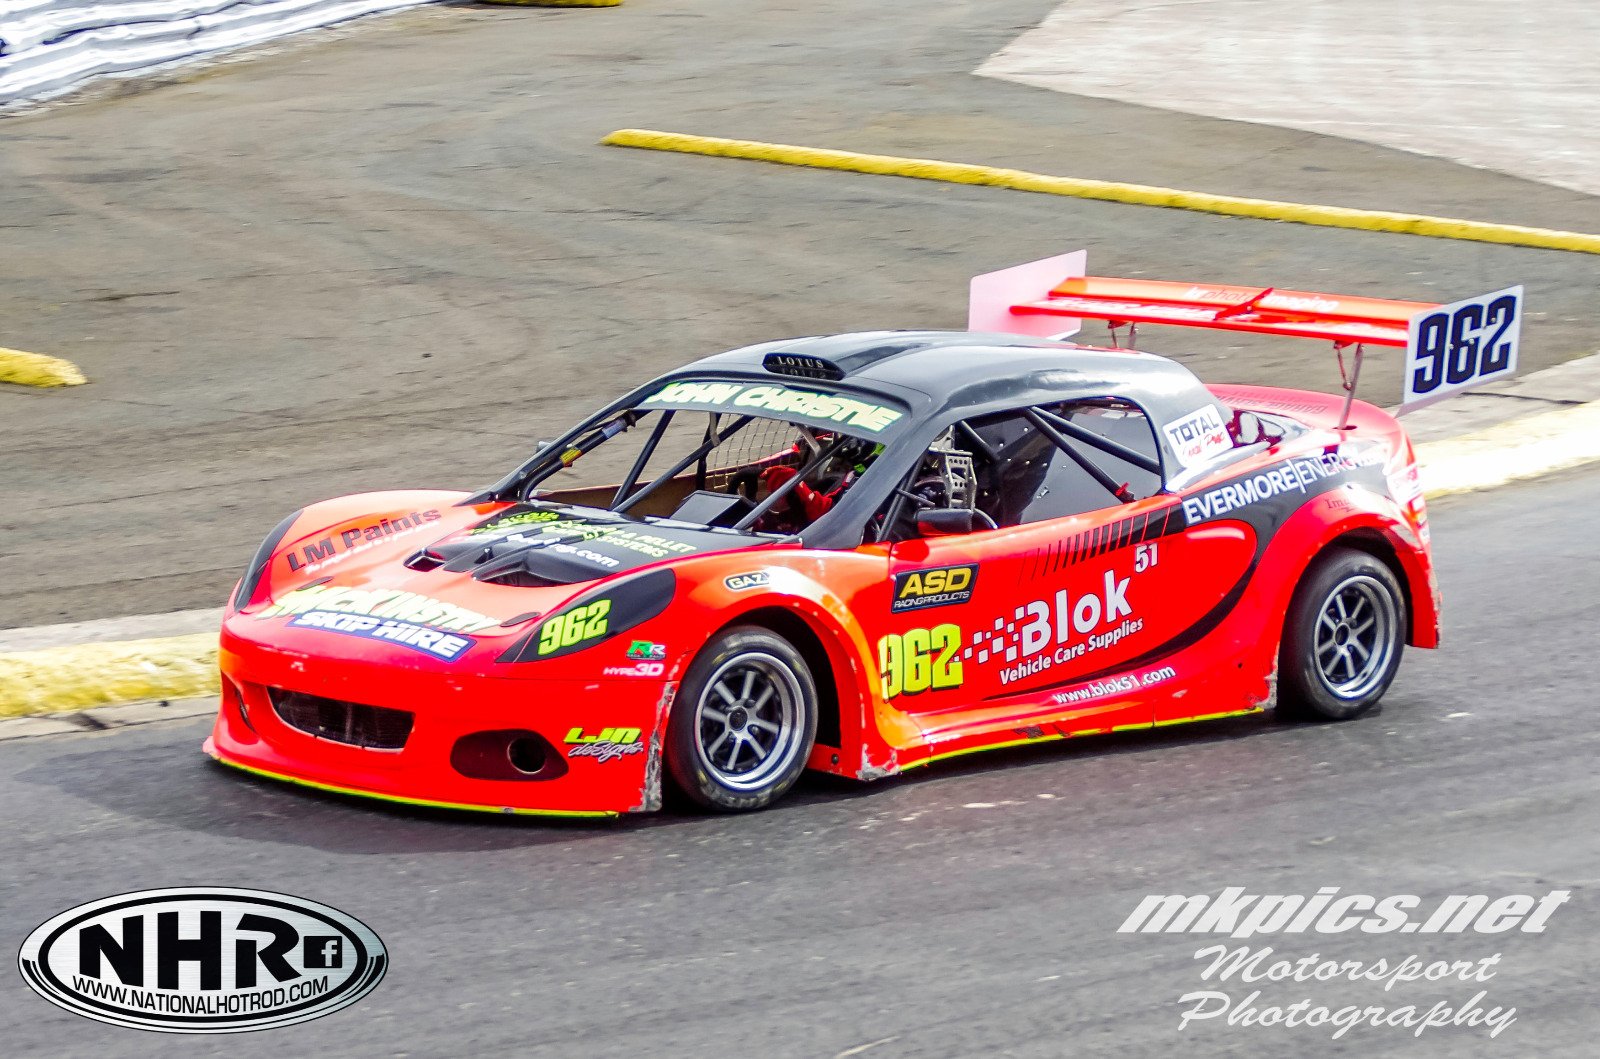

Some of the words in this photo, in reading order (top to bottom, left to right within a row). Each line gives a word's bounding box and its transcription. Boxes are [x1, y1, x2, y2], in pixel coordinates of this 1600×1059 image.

[777, 356, 824, 369] LOTUS
[1413, 295, 1517, 394] 962
[645, 383, 742, 403] JOHN
[734, 387, 903, 432] CHRISTIE
[1169, 413, 1220, 446] TOTAL
[1183, 464, 1299, 524] EVERMORE
[287, 537, 336, 572] LM
[341, 509, 442, 548] Paints
[1135, 543, 1158, 573] 51
[899, 567, 972, 598] ASD
[293, 611, 380, 632] SKIP
[371, 623, 469, 659] HIRE
[537, 599, 612, 656] 962
[1021, 570, 1133, 657] Blok
[877, 623, 964, 704] 962
[1000, 654, 1051, 685] Vehicle
[1054, 645, 1086, 665] Care
[1088, 617, 1144, 652] Supplies
[1052, 665, 1177, 705] www.blok51.com
